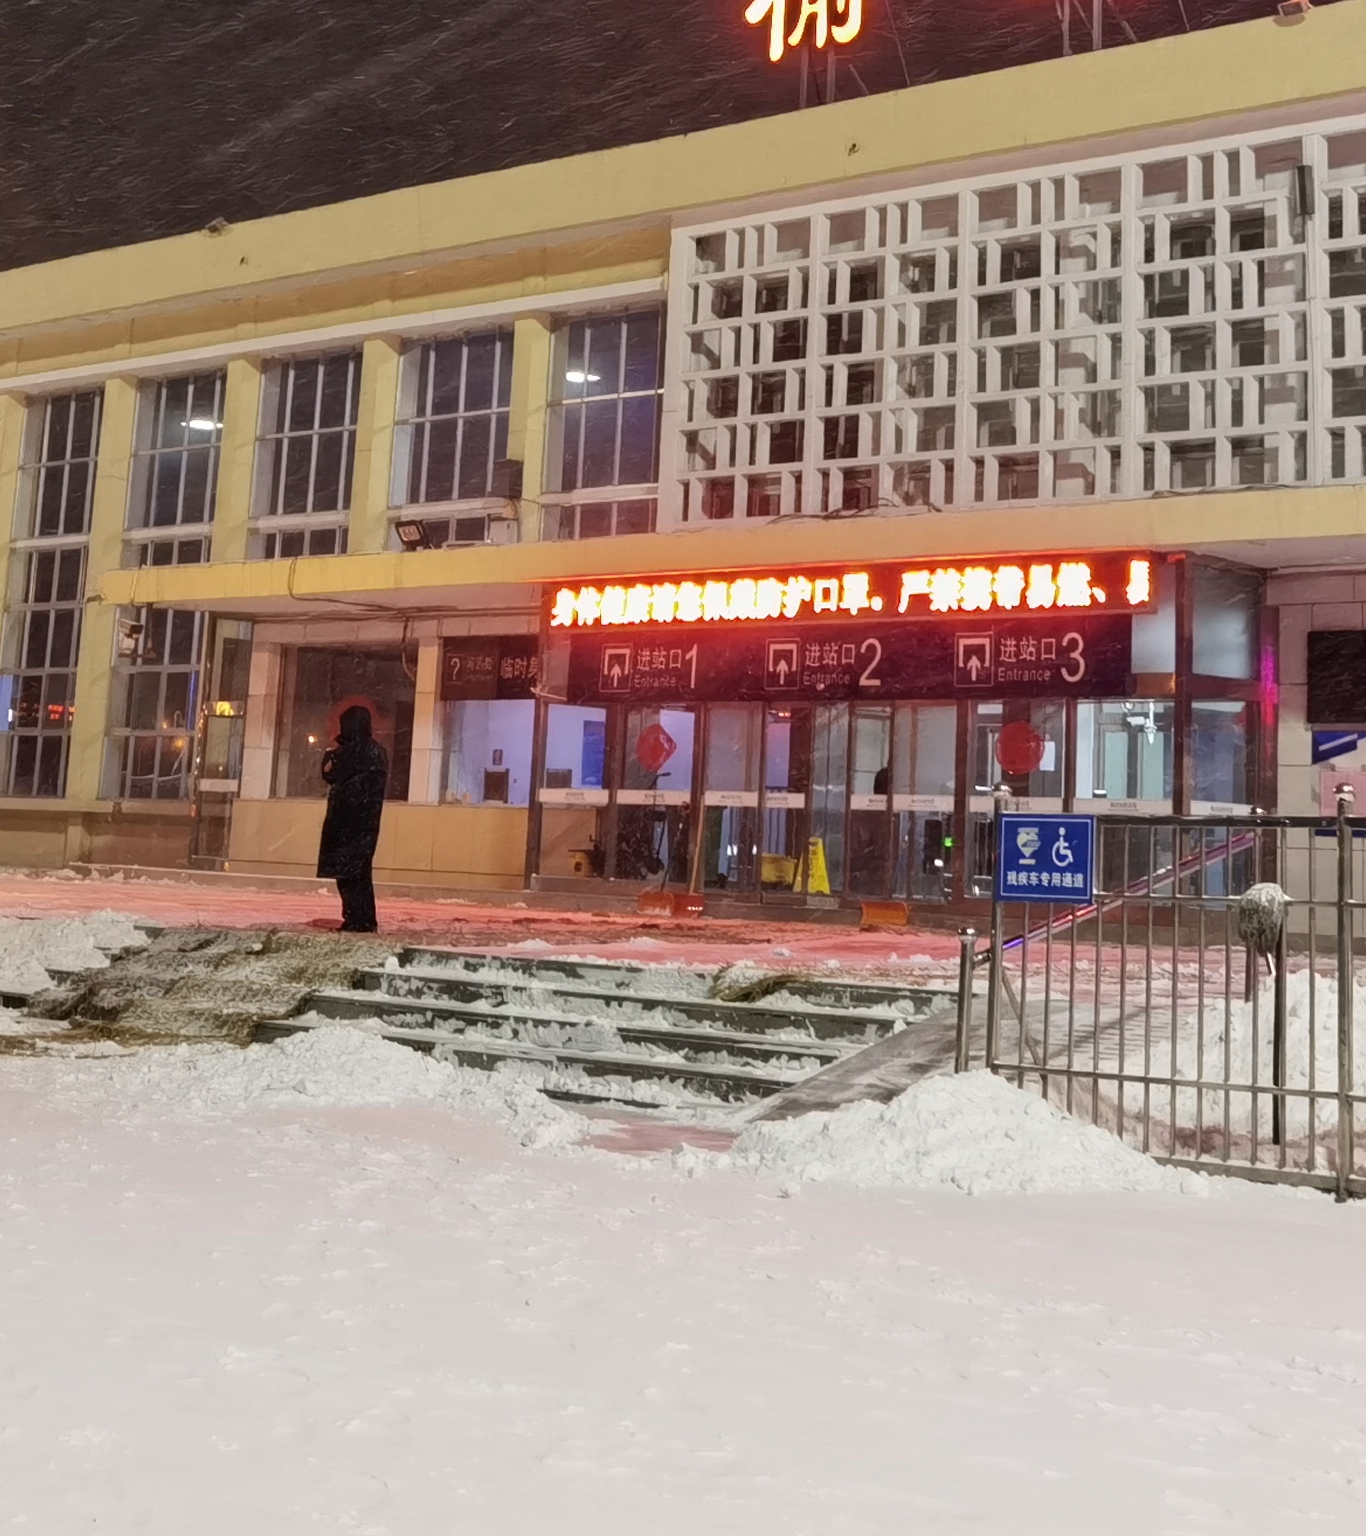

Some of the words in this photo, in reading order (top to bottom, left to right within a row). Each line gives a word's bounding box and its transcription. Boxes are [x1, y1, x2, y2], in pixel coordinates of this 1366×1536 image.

[805, 642, 856, 667] 进站口
[999, 636, 1056, 662] 进站口
[803, 671, 851, 685] Entrance
[998, 667, 1052, 682] Entrance
